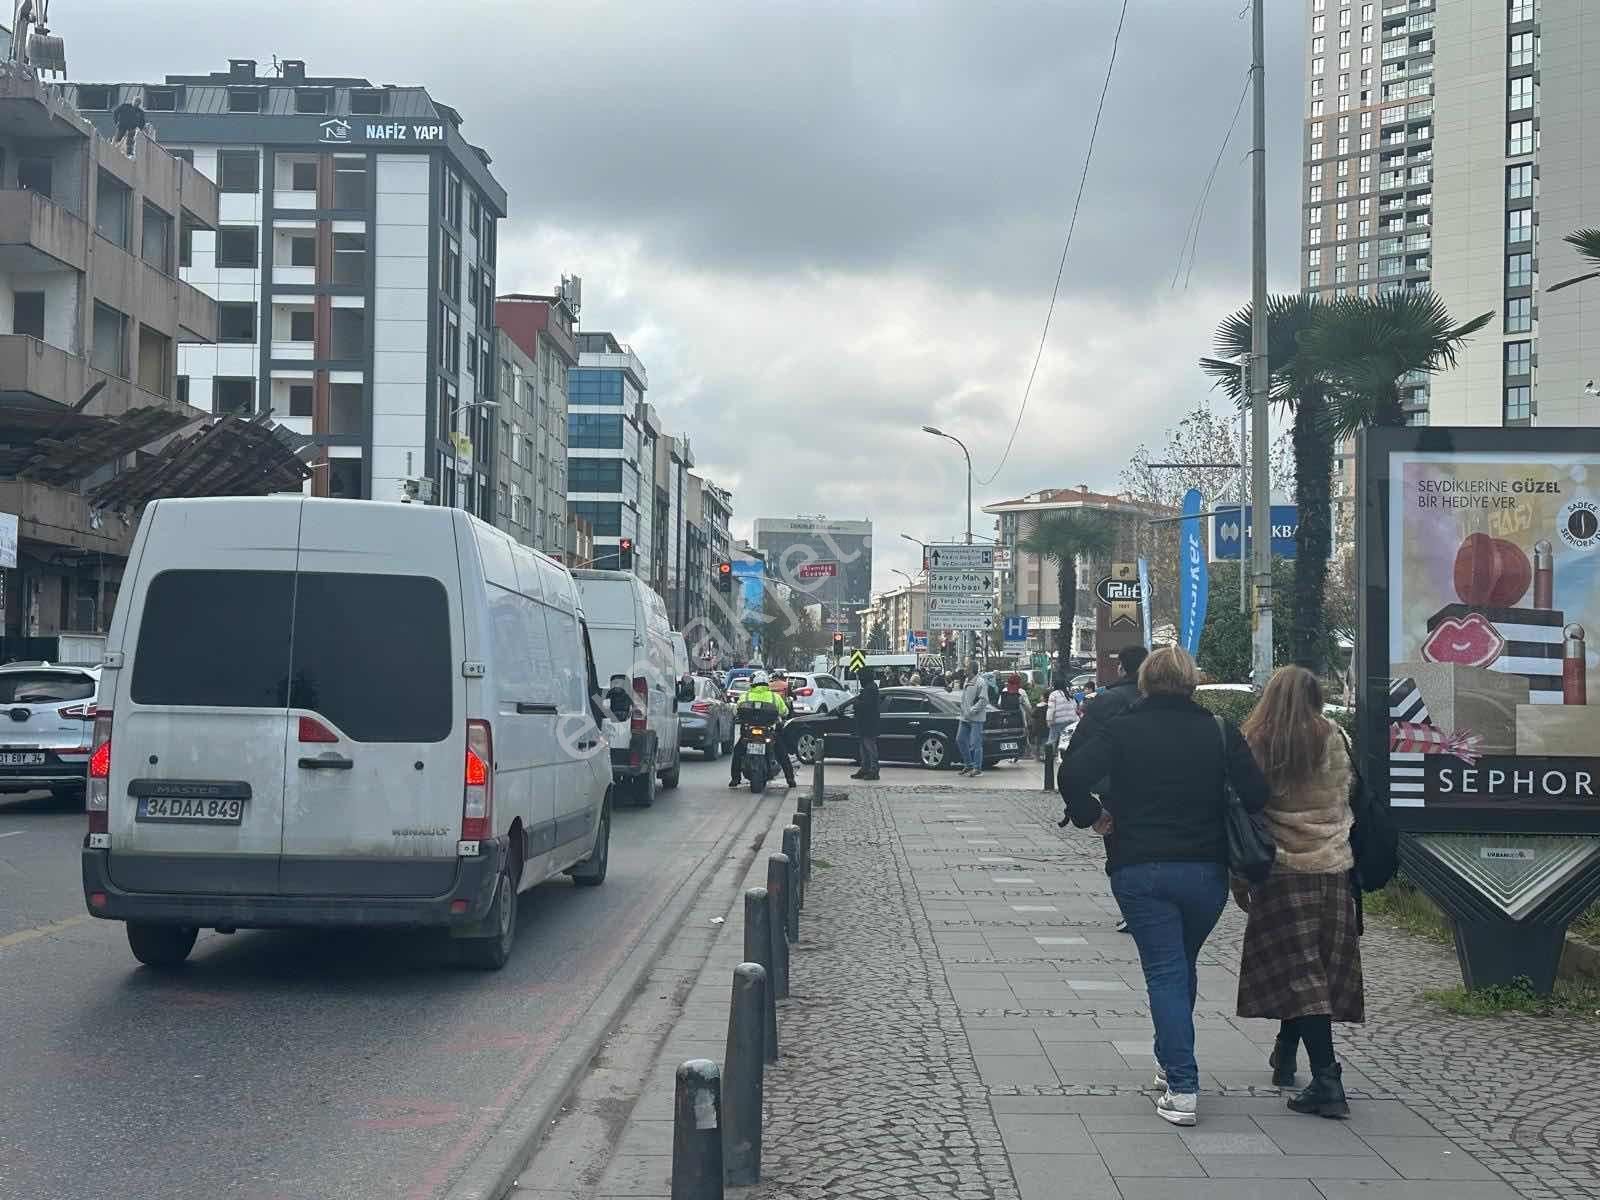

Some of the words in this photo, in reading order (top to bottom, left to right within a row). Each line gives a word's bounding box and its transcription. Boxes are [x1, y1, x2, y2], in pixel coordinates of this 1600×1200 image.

[366, 122, 406, 140] NAFİZ
[412, 125, 444, 140] YAPI
[1418, 479, 1507, 493] SEVDİKLERİNE
[1511, 478, 1562, 493] GÜZEL
[1418, 494, 1438, 508] BİR
[1442, 494, 1488, 508] HEDİYE
[1567, 502, 1599, 513] SADECE
[931, 574, 959, 582] Saray
[1439, 768, 1594, 796] SEPHOR
[207, 802, 240, 818] 849
